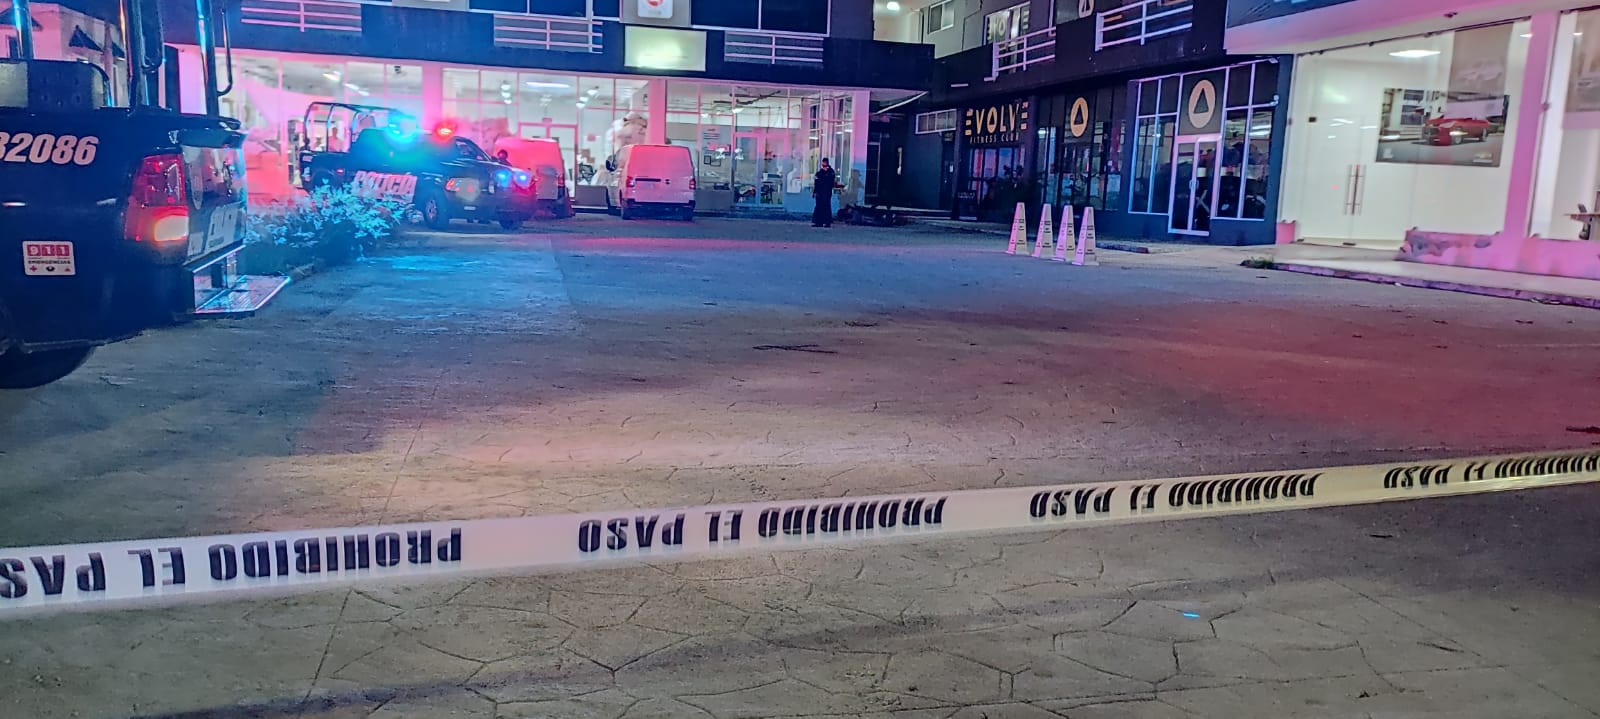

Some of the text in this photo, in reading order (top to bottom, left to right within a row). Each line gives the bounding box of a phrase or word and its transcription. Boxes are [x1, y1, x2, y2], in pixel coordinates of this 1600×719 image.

[965, 101, 1028, 135] EVOLVE
[970, 132, 1019, 144] FITNESS CLUB
[30, 246, 66, 255] 911
[1029, 487, 1118, 518] PASO
[1168, 473, 1325, 507] PROHIBIDO
[578, 496, 948, 552] PROHIBIDO EL PASO
[127, 547, 186, 587] EL
[208, 527, 462, 580] PROHIBIDO
